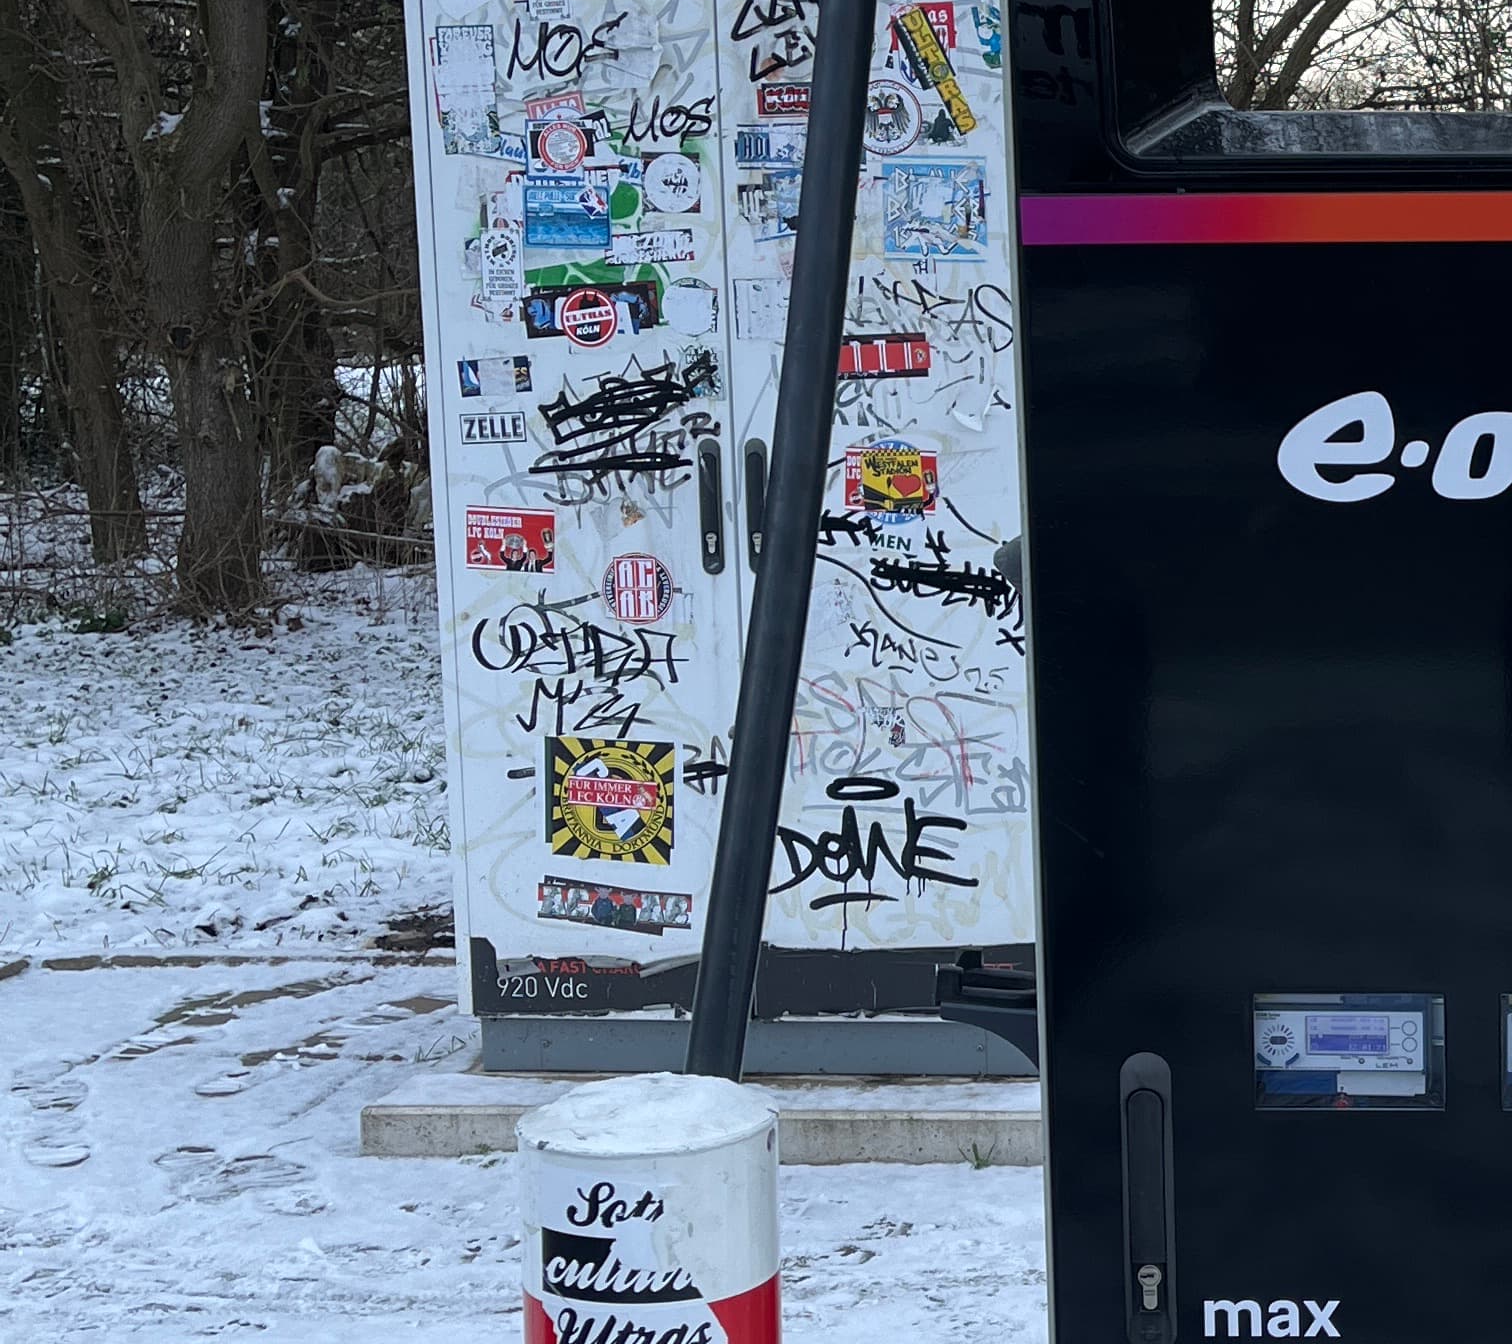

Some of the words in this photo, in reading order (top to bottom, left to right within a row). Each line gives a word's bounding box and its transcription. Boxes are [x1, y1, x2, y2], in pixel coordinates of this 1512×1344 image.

[575, 324, 602, 337] KÖLN
[463, 416, 525, 440] ZELLE
[593, 780, 633, 794] IMMER
[596, 790, 632, 805] KÖLN
[561, 796, 602, 850] BRITANNIA
[612, 804, 666, 852] DORTMUND
[550, 960, 588, 975] FAST
[497, 976, 538, 998] 920
[545, 976, 589, 999] Vdc
[1203, 1299, 1342, 1338] max
